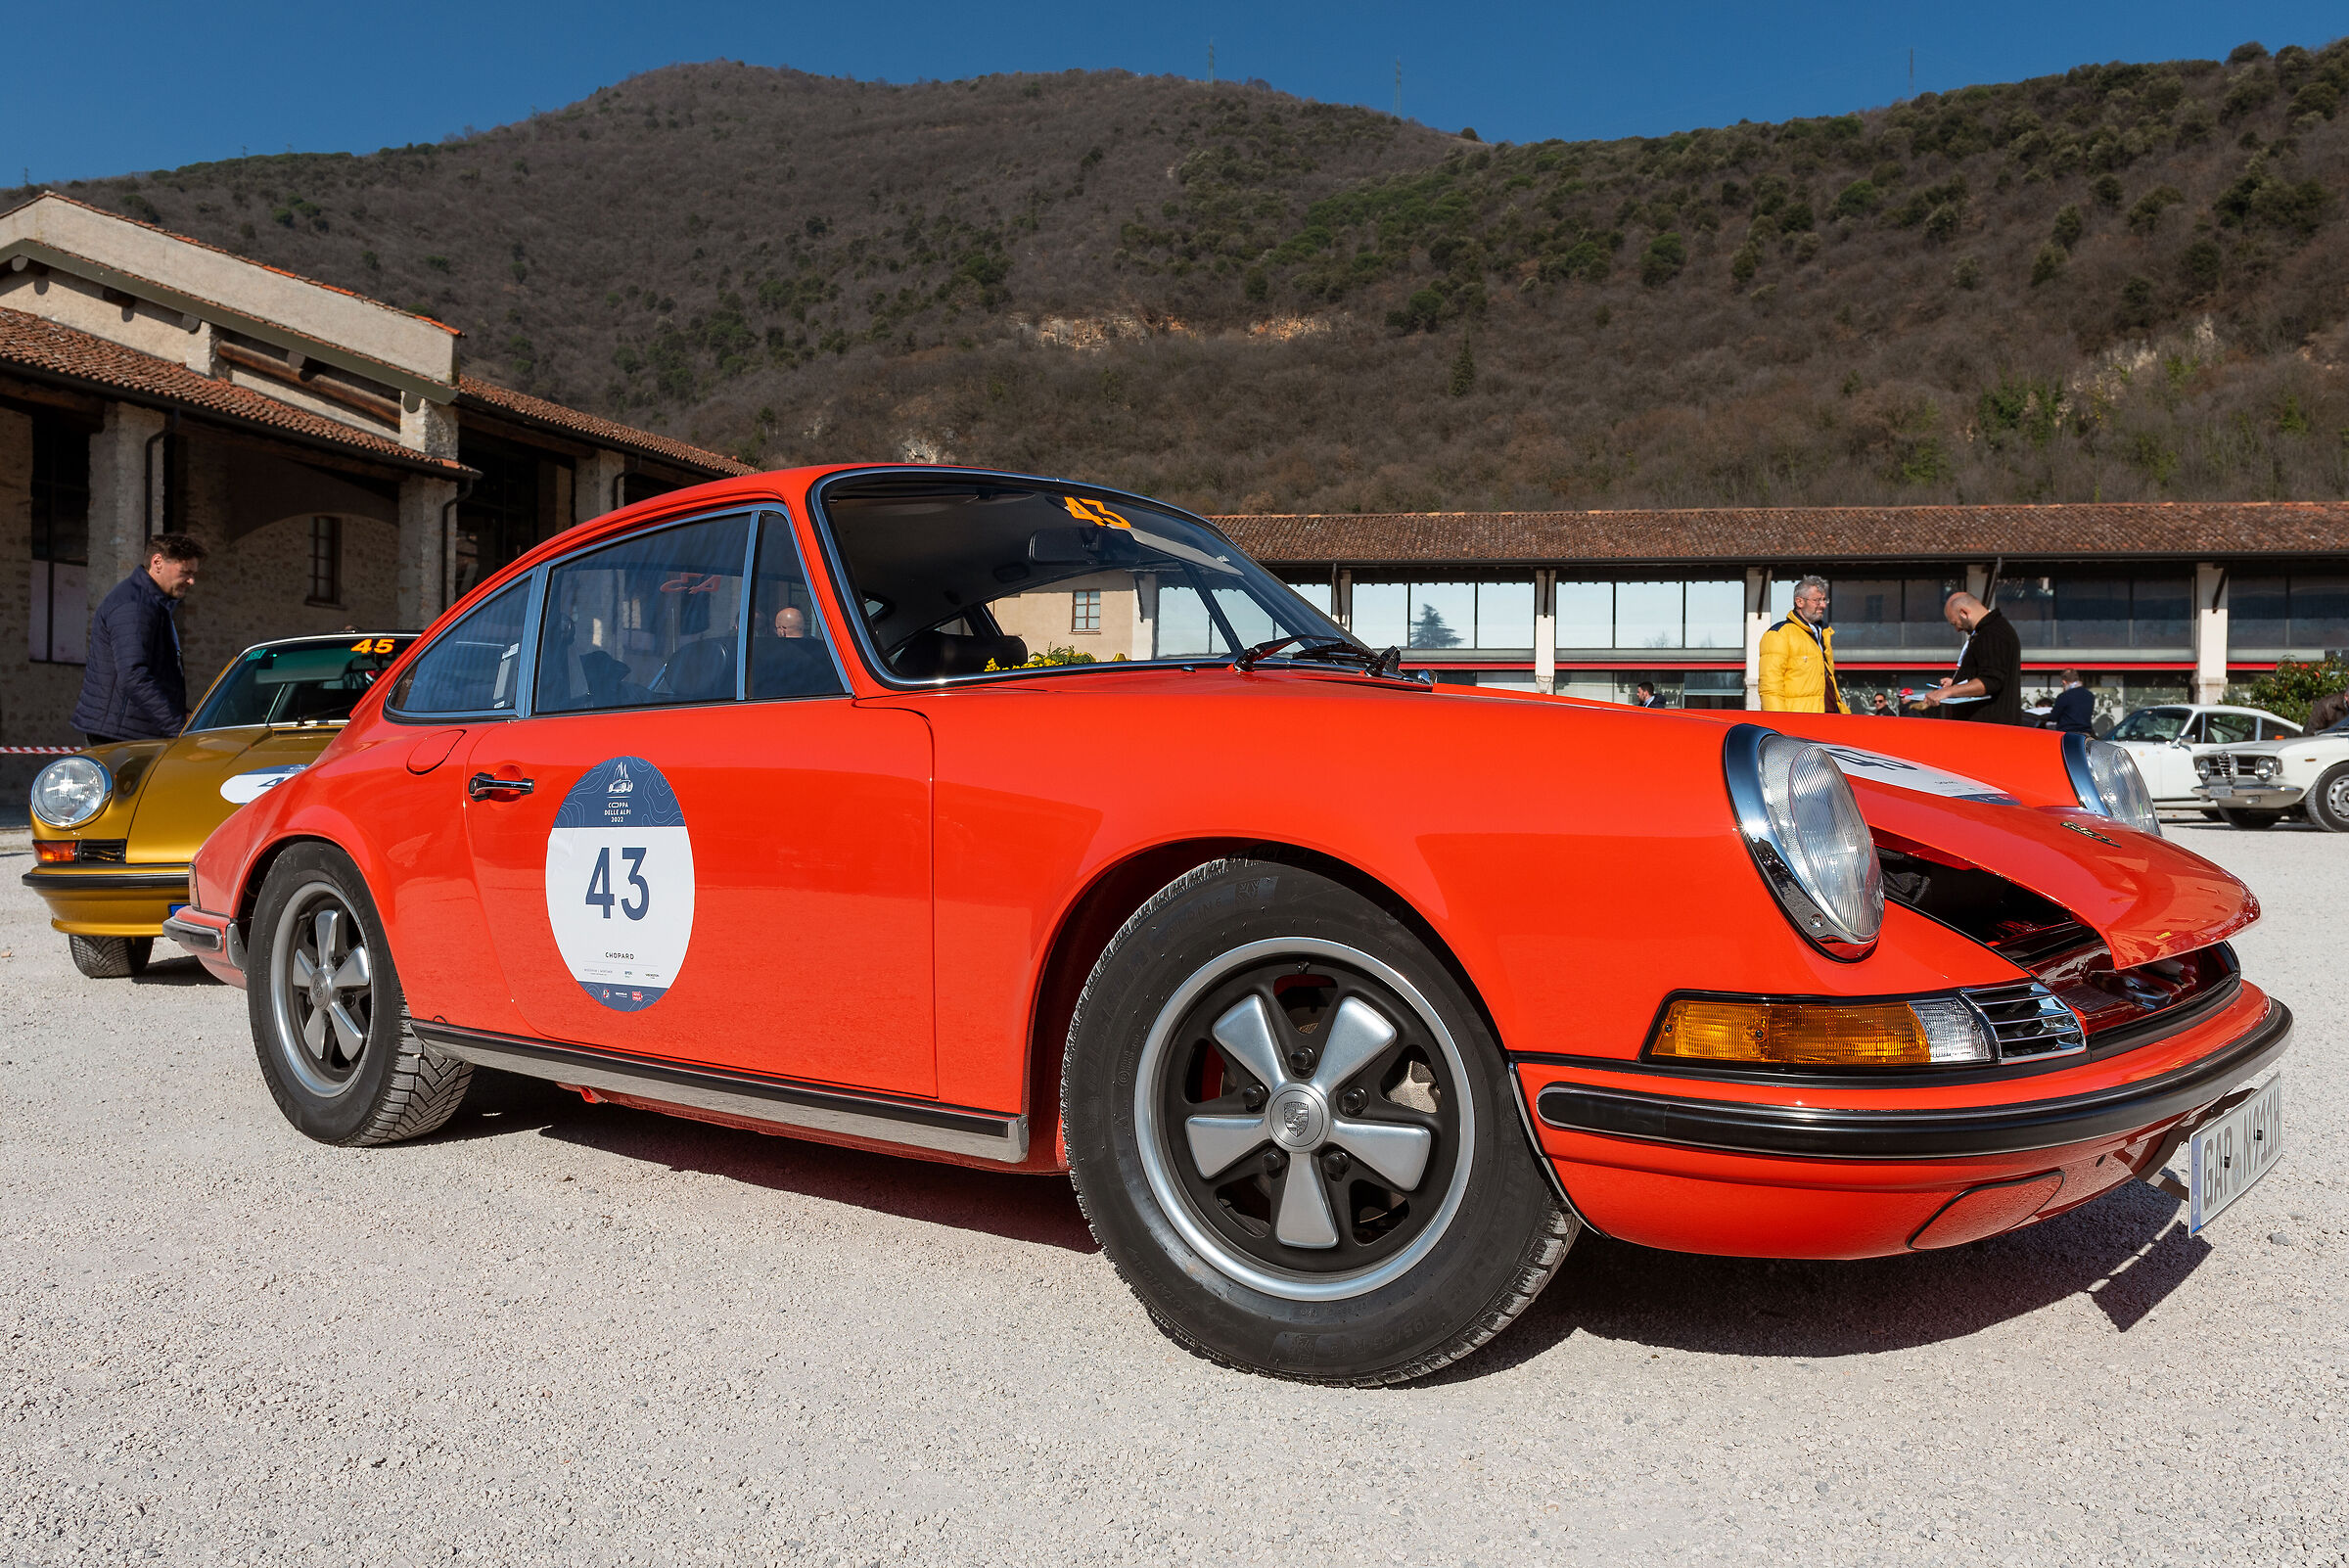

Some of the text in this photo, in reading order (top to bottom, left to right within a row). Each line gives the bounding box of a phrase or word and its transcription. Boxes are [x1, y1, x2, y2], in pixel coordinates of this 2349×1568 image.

[1064, 496, 1131, 529] 43
[350, 638, 395, 654] 45
[585, 847, 650, 922] 43
[605, 951, 635, 960] CHOPARD
[2203, 1126, 2233, 1211] GAP
